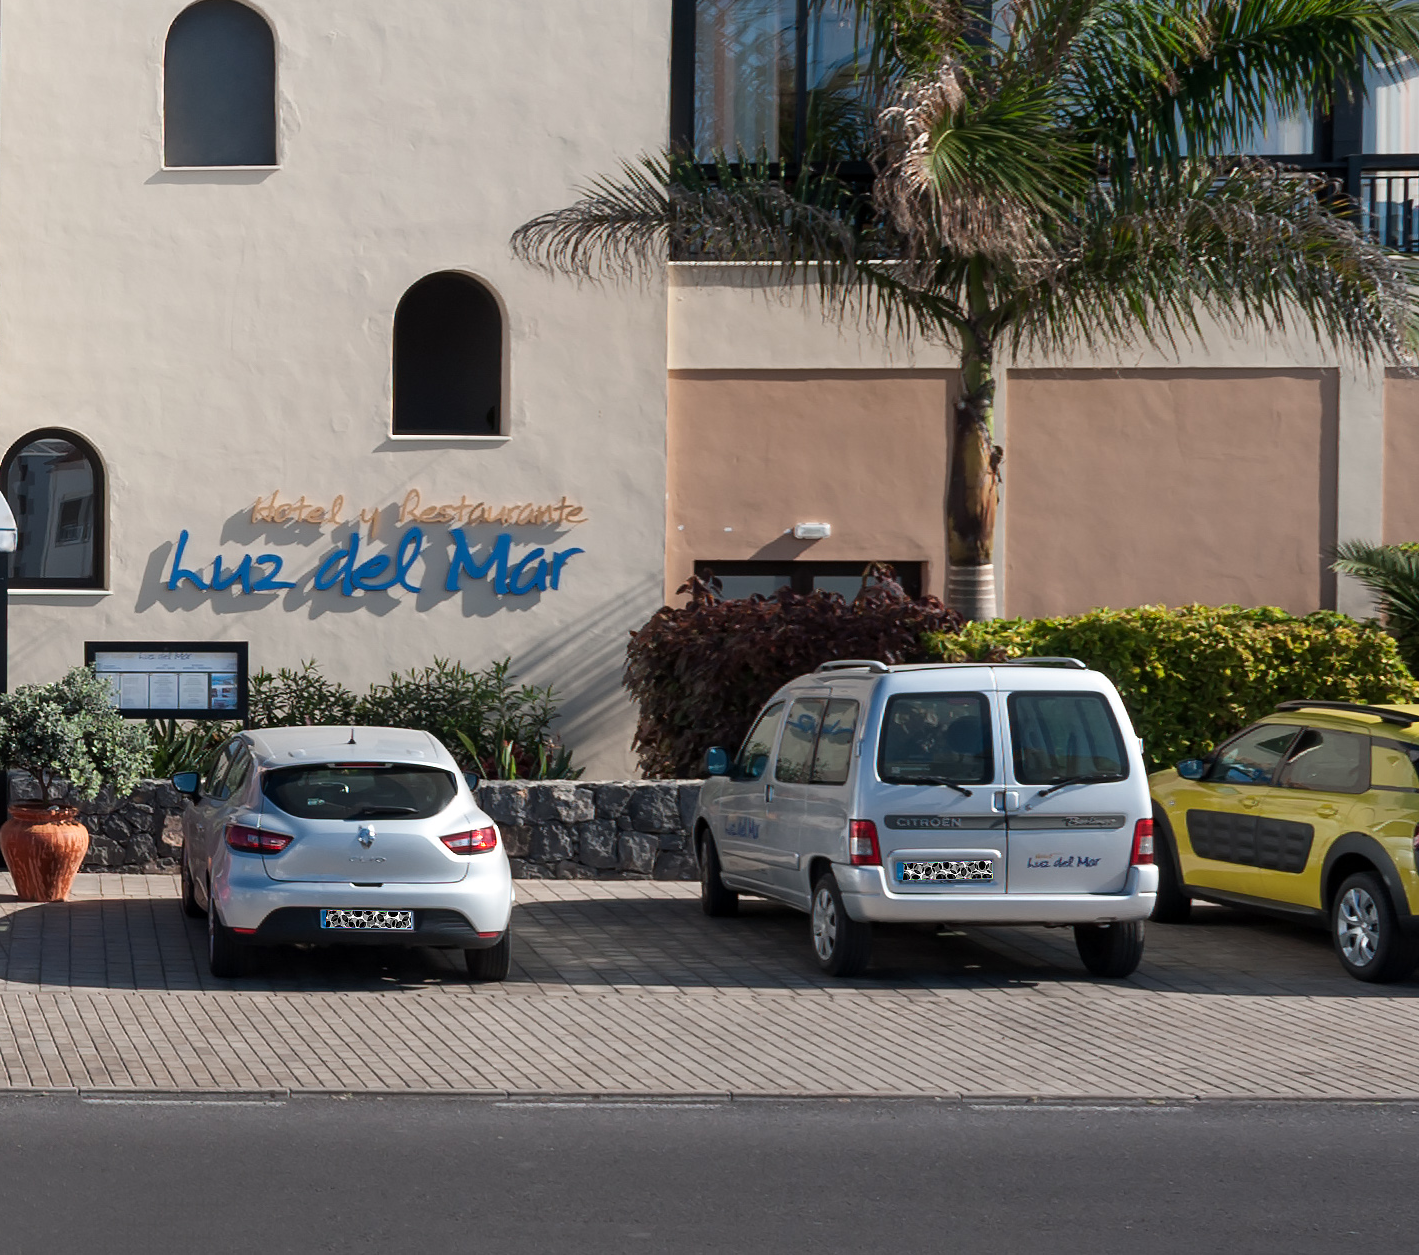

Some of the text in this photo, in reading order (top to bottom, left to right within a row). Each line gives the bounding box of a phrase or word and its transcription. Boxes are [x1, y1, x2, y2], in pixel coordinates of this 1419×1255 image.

[251, 488, 590, 539] Hotel y Restaurante
[167, 526, 585, 597] Luz del Mar
[1053, 856, 1074, 868] del
[1077, 856, 1102, 868] Mar
